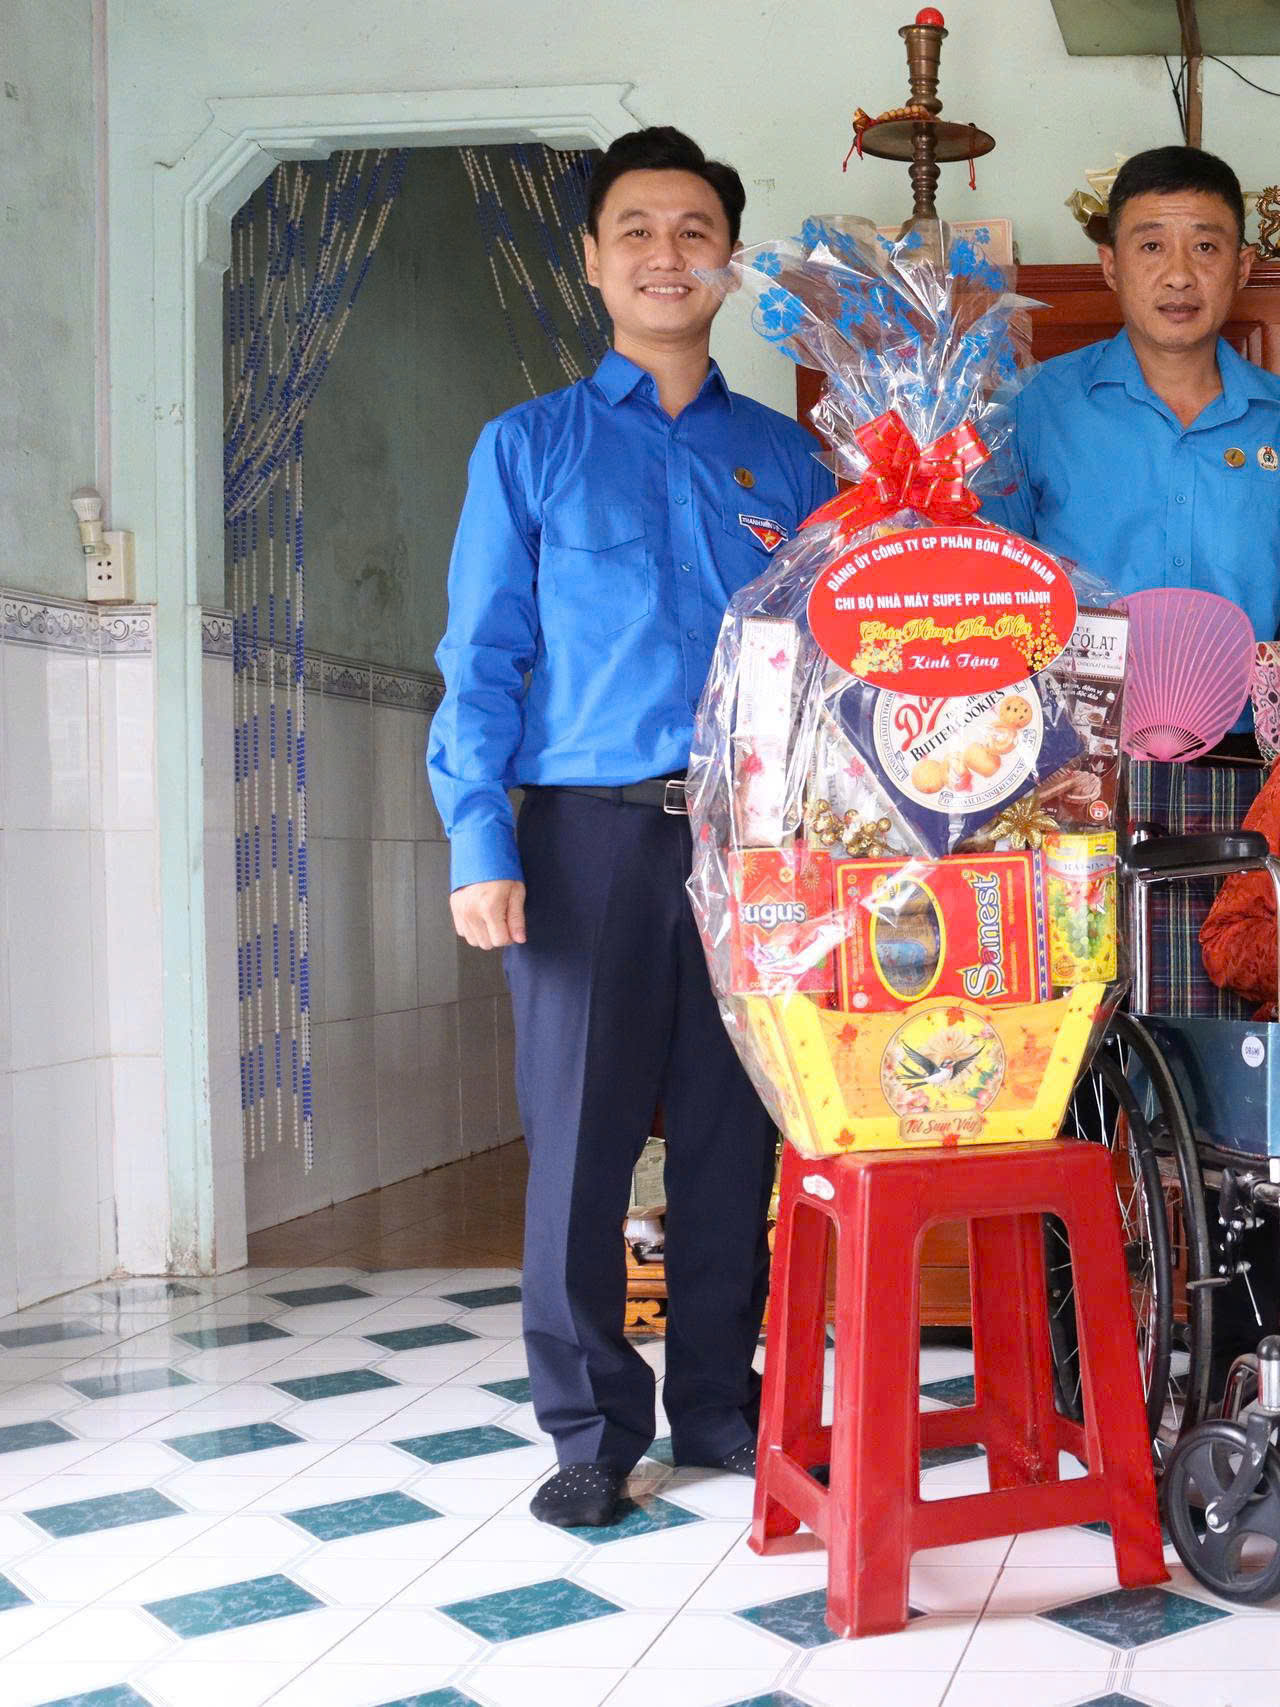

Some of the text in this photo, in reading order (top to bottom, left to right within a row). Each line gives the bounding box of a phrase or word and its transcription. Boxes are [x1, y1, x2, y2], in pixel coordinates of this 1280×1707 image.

[826, 562, 857, 592] ĐẢNG
[854, 553, 871, 569] ỦY
[871, 541, 905, 561] CÔNG
[904, 538, 919, 552] TY
[921, 536, 938, 549] CP
[940, 534, 972, 549] PHÂN
[975, 537, 999, 554] BÓN
[1030, 559, 1057, 585] NAM
[834, 588, 1051, 612] CHI BỘ NHÀ MÁY SUPE PP LONG THÀNH
[962, 872, 1006, 998] Sanest
